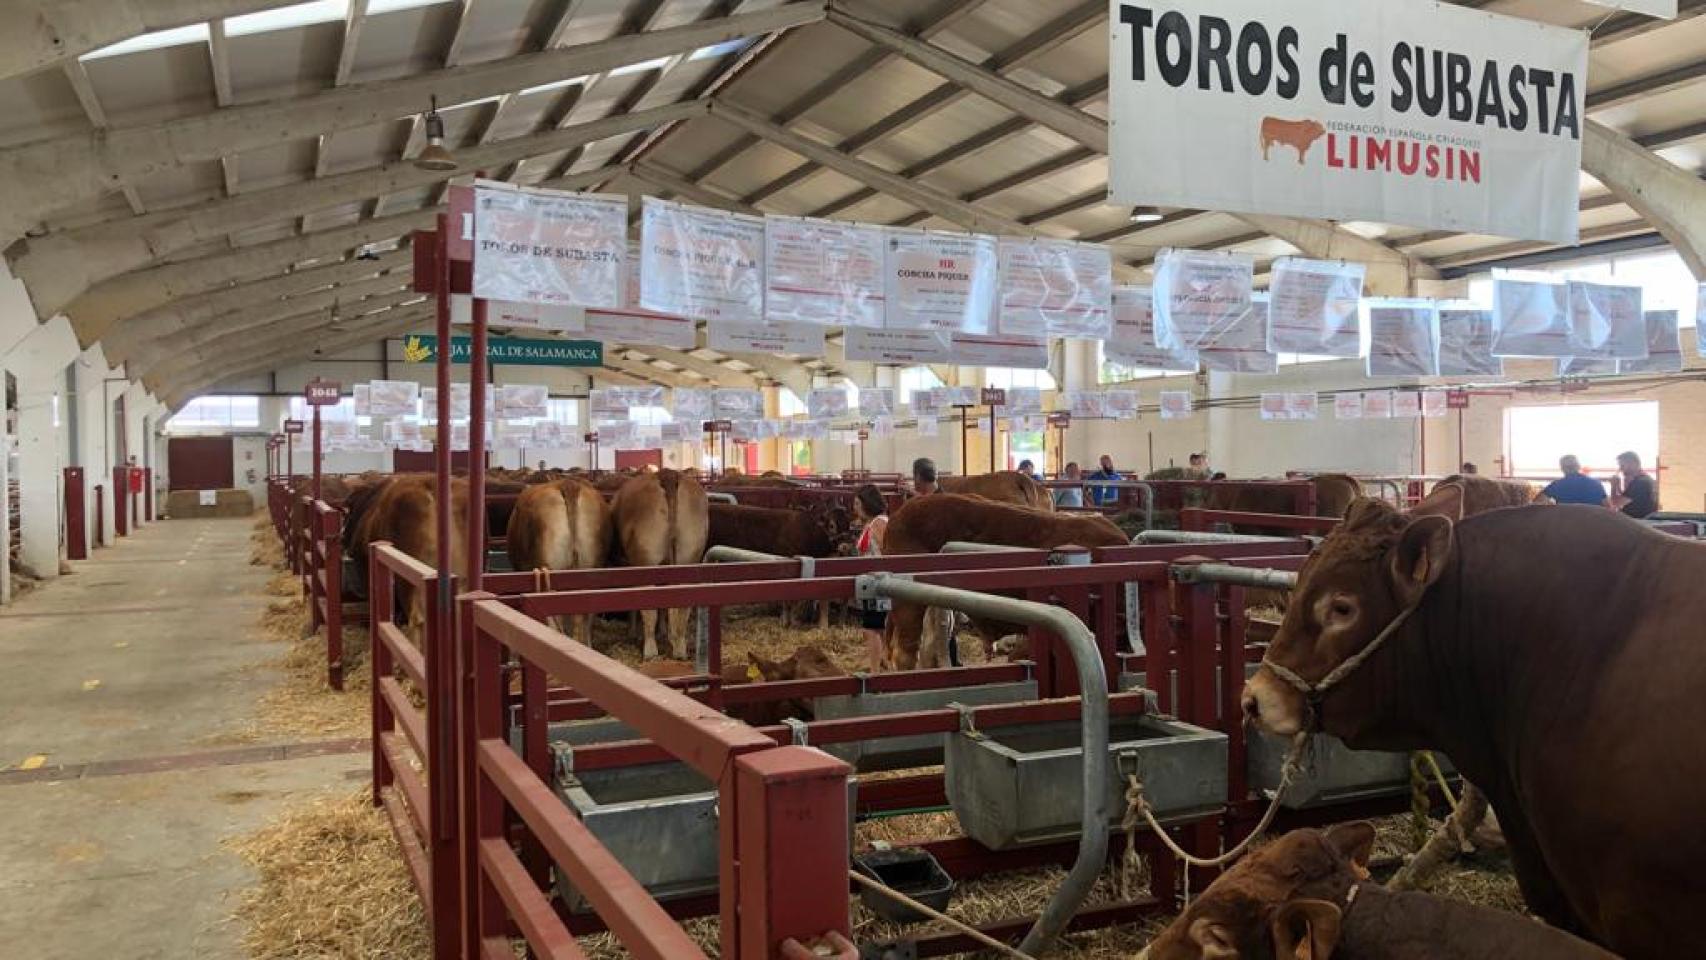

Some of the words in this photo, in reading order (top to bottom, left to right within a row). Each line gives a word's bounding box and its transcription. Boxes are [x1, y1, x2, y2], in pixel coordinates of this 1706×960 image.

[1120, 4, 1299, 100] TOROS
[1319, 33, 1375, 108] de
[1391, 41, 1580, 139] SUBASTA
[1327, 133, 1481, 184] LIMUSIN
[532, 245, 553, 257] DE
[556, 247, 619, 263] SUBASTA
[897, 269, 936, 280] CONCHA
[508, 347, 527, 357] DE
[526, 347, 599, 360] SALAMANCA
